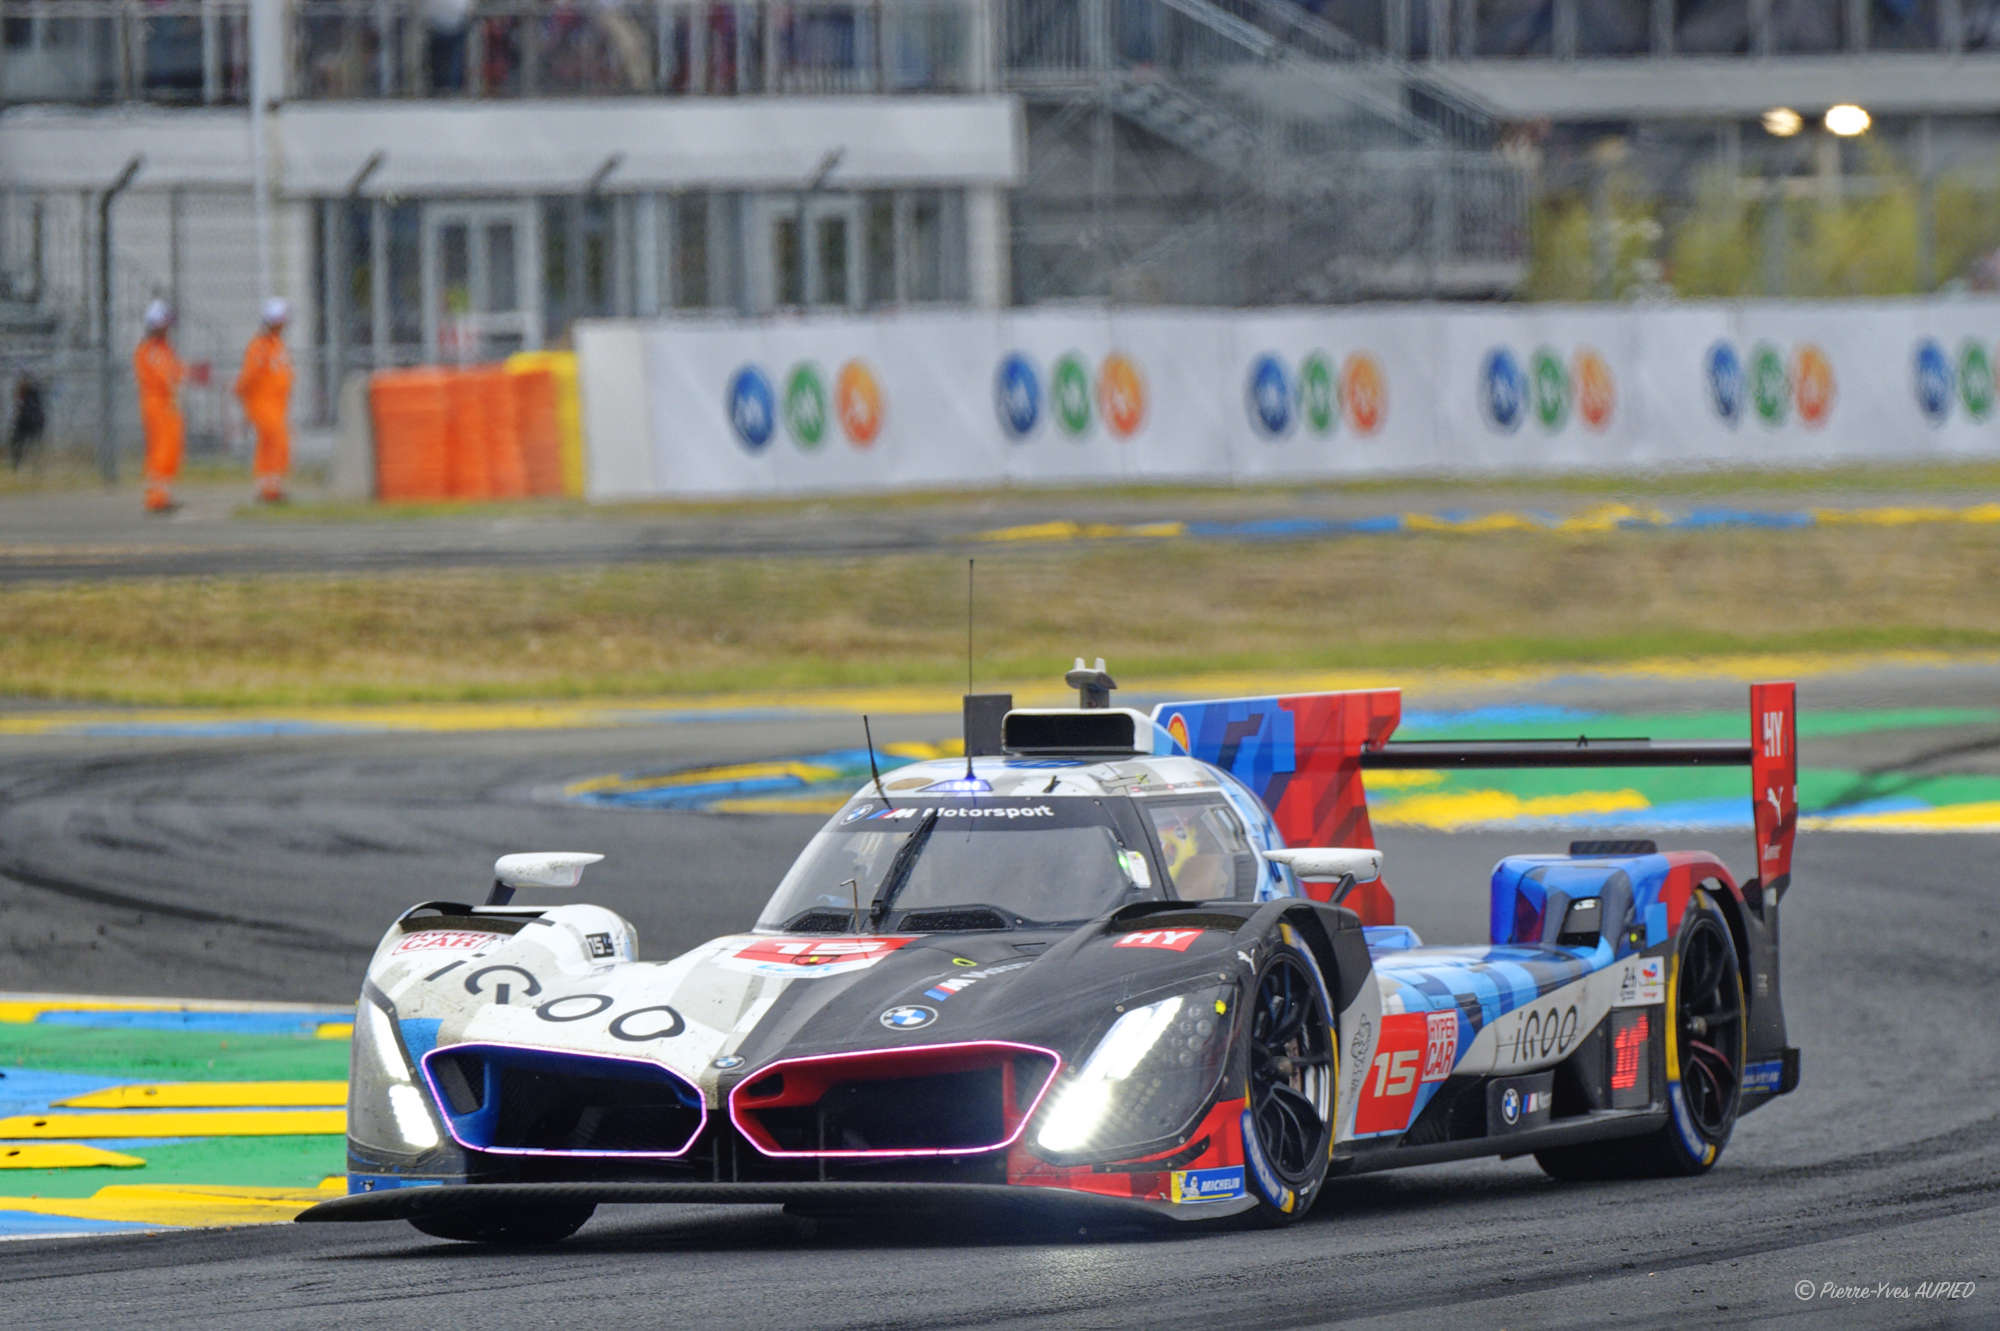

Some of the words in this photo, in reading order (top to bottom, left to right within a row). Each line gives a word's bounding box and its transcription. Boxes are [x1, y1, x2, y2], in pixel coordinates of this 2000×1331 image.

[1119, 930, 1197, 945] HY
[775, 941, 888, 955] 15
[1424, 1040, 1455, 1078] CAR
[1373, 1049, 1420, 1098] 15
[1201, 1177, 1241, 1193] MICHELIN
